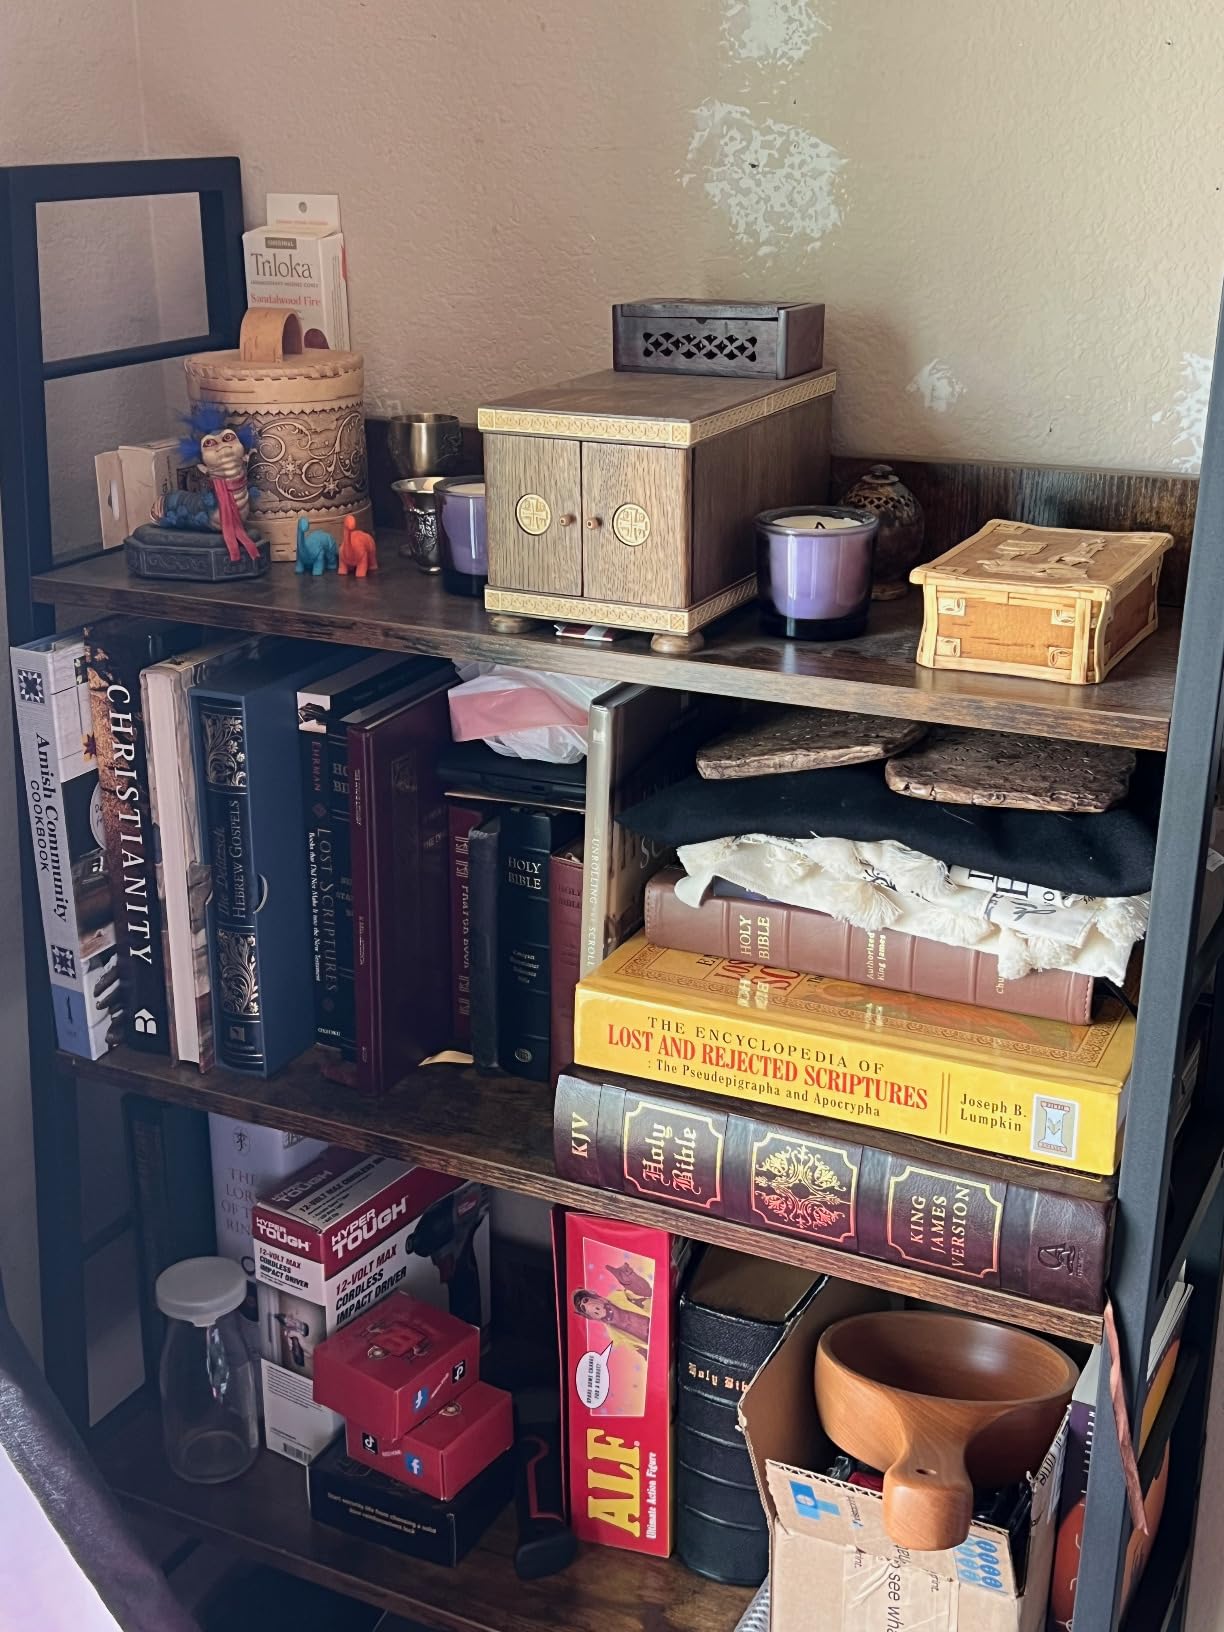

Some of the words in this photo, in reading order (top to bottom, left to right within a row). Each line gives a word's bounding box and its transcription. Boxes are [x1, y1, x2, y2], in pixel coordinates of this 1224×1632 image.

[250, 253, 313, 279] Triloka
[250, 293, 301, 305] Sandalwood
[36, 733, 57, 799] Amish
[312, 741, 321, 791] EHRMAN
[31, 780, 50, 872] COOKBOOK
[106, 684, 152, 964] CHRISTIANITY
[228, 800, 243, 859] GOSPELS
[45, 805, 69, 922] Community
[317, 828, 333, 873] LOST
[508, 857, 542, 874] HOLY
[588, 838, 601, 904] UNROLLING
[230, 863, 247, 918] HEBREW
[508, 872, 542, 890] BIBLE
[320, 881, 337, 991] SCRIPTURES
[587, 927, 597, 967] SCROLL
[739, 915, 752, 957] HOLY
[757, 916, 770, 960] BIBLE
[877, 960, 886, 982] King
[608, 1023, 654, 1053] LOST
[658, 1034, 696, 1061] AND
[701, 1042, 798, 1082] REJECTED
[804, 1064, 928, 1110] SCRIPTURES
[647, 1016, 685, 1034] THE
[696, 1026, 848, 1068] ENCYCLOPEDIA
[859, 1059, 885, 1075] OF
[656, 1058, 678, 1074] The
[682, 1064, 781, 1096] Pseudepigrapha
[785, 1088, 808, 1101] and
[813, 1091, 880, 1117] Apocrypha
[960, 1093, 1008, 1113] Joseph
[1014, 1103, 1027, 1118] B.
[571, 1111, 591, 1158] KJV
[960, 1108, 1022, 1132] Lumpkin
[641, 1122, 673, 1186] Holy
[672, 1127, 702, 1195] Bible
[226, 1184, 256, 1202] LOR
[225, 1219, 251, 1236] RIN
[256, 1217, 286, 1232] HYPER
[256, 1223, 310, 1252] TOUGH
[331, 1208, 376, 1246] HYPER
[332, 1197, 407, 1259] TOUGH
[910, 1195, 926, 1243] KING
[930, 1195, 947, 1255] JAMES
[951, 1185, 970, 1267] VERSION
[259, 1247, 285, 1265] 12-VOLT
[286, 1258, 302, 1269] MAX
[259, 1256, 291, 1274] CORDLESS
[260, 1265, 284, 1280] IMPACT
[285, 1274, 309, 1289] DRIVER
[336, 1262, 374, 1296] 12-VOLT
[376, 1244, 398, 1268] MAX
[335, 1268, 384, 1311] CORDLESS
[336, 1291, 372, 1325] IMPACT
[374, 1266, 407, 1299] DRIVER
[688, 1362, 718, 1386] Holy
[724, 1376, 748, 1393] Bib
[587, 1428, 640, 1537] ALF
[646, 1451, 658, 1478] Figure
[646, 1480, 657, 1505] Action
[646, 1506, 657, 1539] Ultimate
[888, 1572, 901, 1602] see
